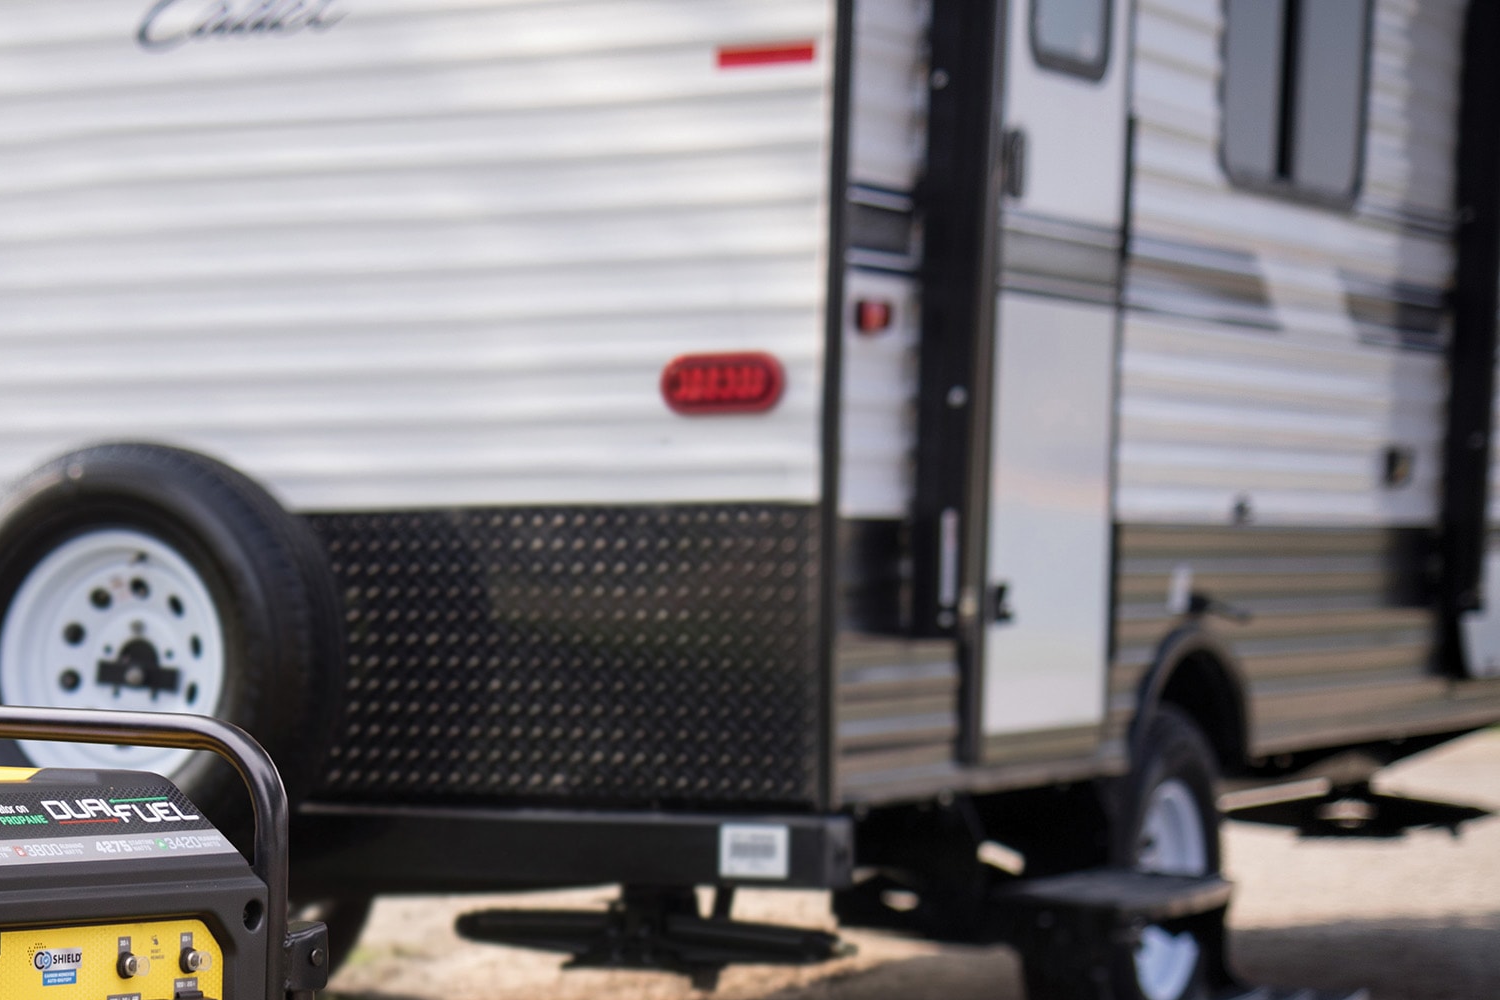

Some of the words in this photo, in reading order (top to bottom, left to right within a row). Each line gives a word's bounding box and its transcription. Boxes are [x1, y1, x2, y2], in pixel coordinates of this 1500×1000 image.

[15, 805, 29, 813] on
[95, 839, 133, 854] 4275
[164, 836, 203, 850] 3420
[24, 844, 64, 857] 3800
[53, 953, 81, 965] SHIELD
